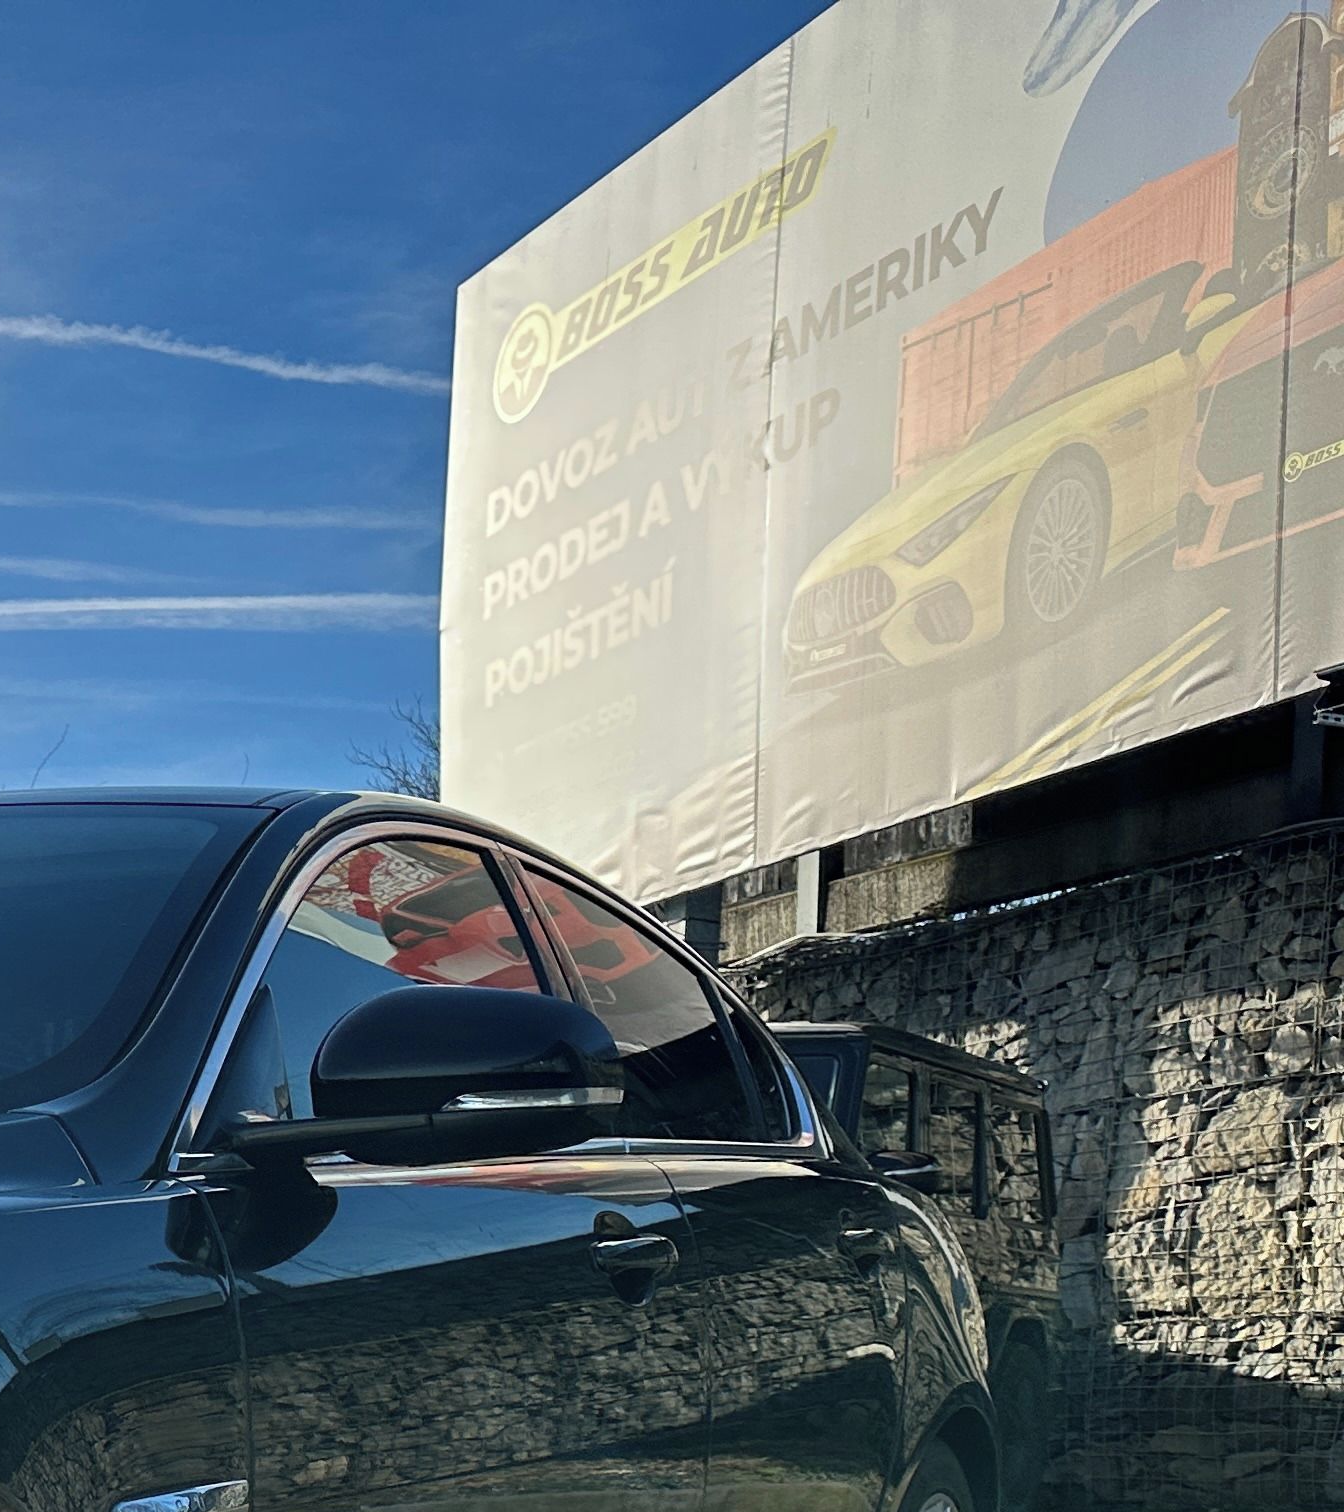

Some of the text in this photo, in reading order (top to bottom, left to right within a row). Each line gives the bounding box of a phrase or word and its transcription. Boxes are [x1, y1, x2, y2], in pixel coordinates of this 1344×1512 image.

[558, 138, 828, 359] BOSS AUTO
[486, 418, 620, 538] DOVOZ
[758, 185, 1005, 383] AMERIKY
[1304, 442, 1341, 468] BOSS
[483, 499, 632, 621] PRODEJ
[639, 480, 672, 538] A
[484, 554, 678, 708] POJIŠTĚNÍ
